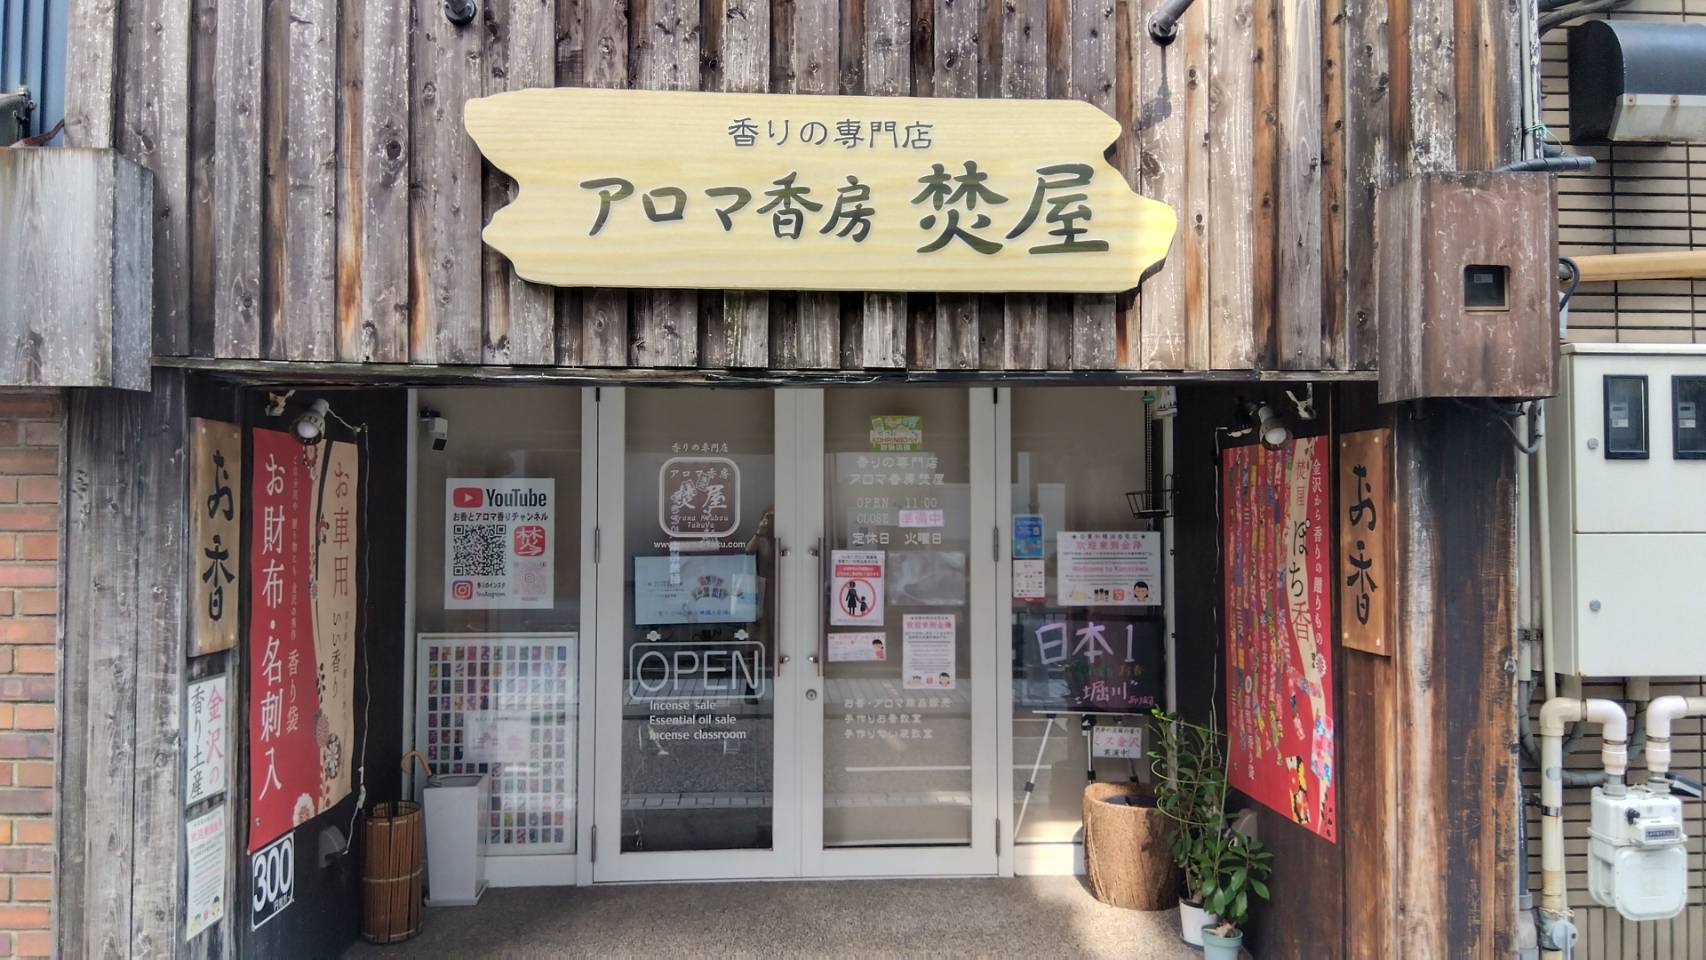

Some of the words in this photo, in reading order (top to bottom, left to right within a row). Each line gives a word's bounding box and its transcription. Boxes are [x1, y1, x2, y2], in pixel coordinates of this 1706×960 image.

[728, 117, 934, 150] 香りの専門店
[581, 171, 876, 243] アロマ香房
[911, 161, 1110, 255] 焚屋
[671, 442, 729, 453] 香りの専門店
[856, 456, 939, 469] 香りの専門店
[486, 488, 547, 507] YouTube
[857, 497, 889, 508] OPEN
[332, 461, 350, 598] お車用
[856, 512, 889, 525] CLOSE
[202, 450, 236, 621] お香
[852, 532, 890, 545] 定休日
[904, 532, 942, 545] 火曜日
[1347, 463, 1378, 625] お香
[259, 453, 286, 800] お財布・名刺入
[637, 650, 759, 691] OPEN
[650, 701, 690, 711] Incense
[695, 702, 716, 711] sale
[650, 715, 696, 726] Essential
[698, 715, 712, 725] oil
[715, 715, 737, 725] sale
[205, 685, 224, 786] 金沢の
[650, 730, 690, 740] Incense
[694, 730, 747, 740] classroom
[254, 839, 293, 912] 300
